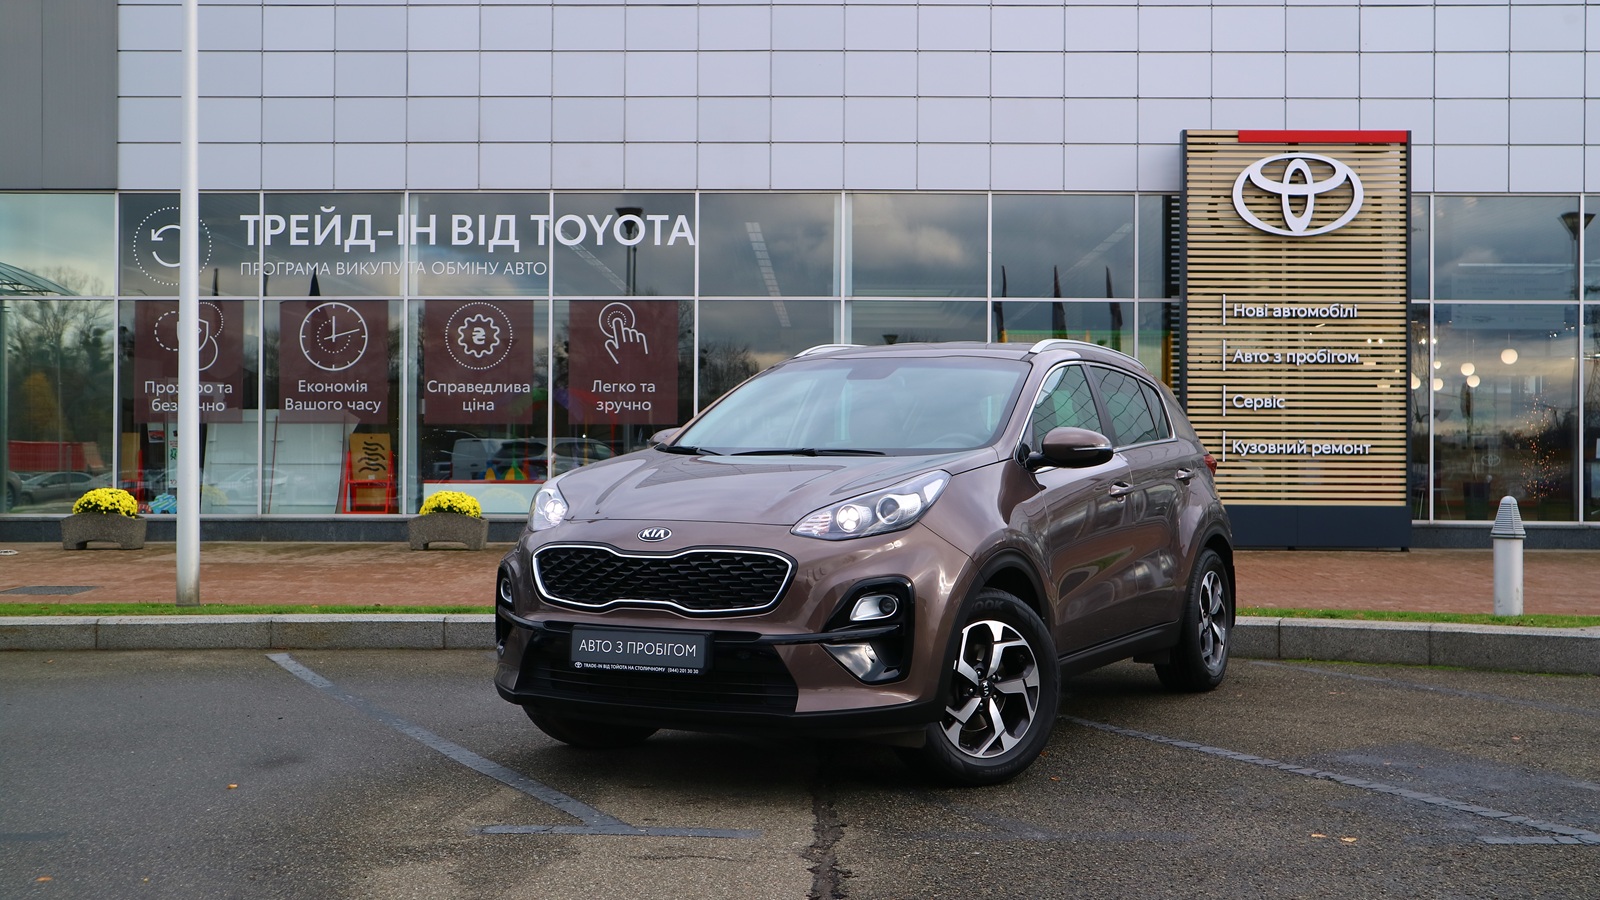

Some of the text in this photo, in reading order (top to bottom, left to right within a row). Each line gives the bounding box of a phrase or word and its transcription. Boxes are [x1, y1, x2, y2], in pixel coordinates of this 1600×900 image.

[239, 205, 436, 253] ТРЕЙД-ІН
[451, 214, 520, 253] ВІД
[240, 261, 547, 276] ПРОГРАМА ВИКУПУ ТА ОБМІНУ АВТО
[1233, 303, 1358, 318] Нові автомобілі
[1232, 348, 1359, 366] Авто з пробігом
[217, 384, 233, 394] та
[298, 380, 368, 392] Економія
[426, 380, 531, 394] Справедлива
[591, 380, 656, 393] Легко та
[285, 398, 381, 413] Вашого часу
[462, 398, 494, 412] ціна
[596, 401, 651, 414] зручно
[1232, 394, 1286, 410] Сервіс
[1232, 440, 1371, 457] Кузовний ремонт
[642, 528, 666, 538] KIA
[578, 639, 613, 653] АВТО
[626, 641, 697, 657] ПРОБІГОМ
